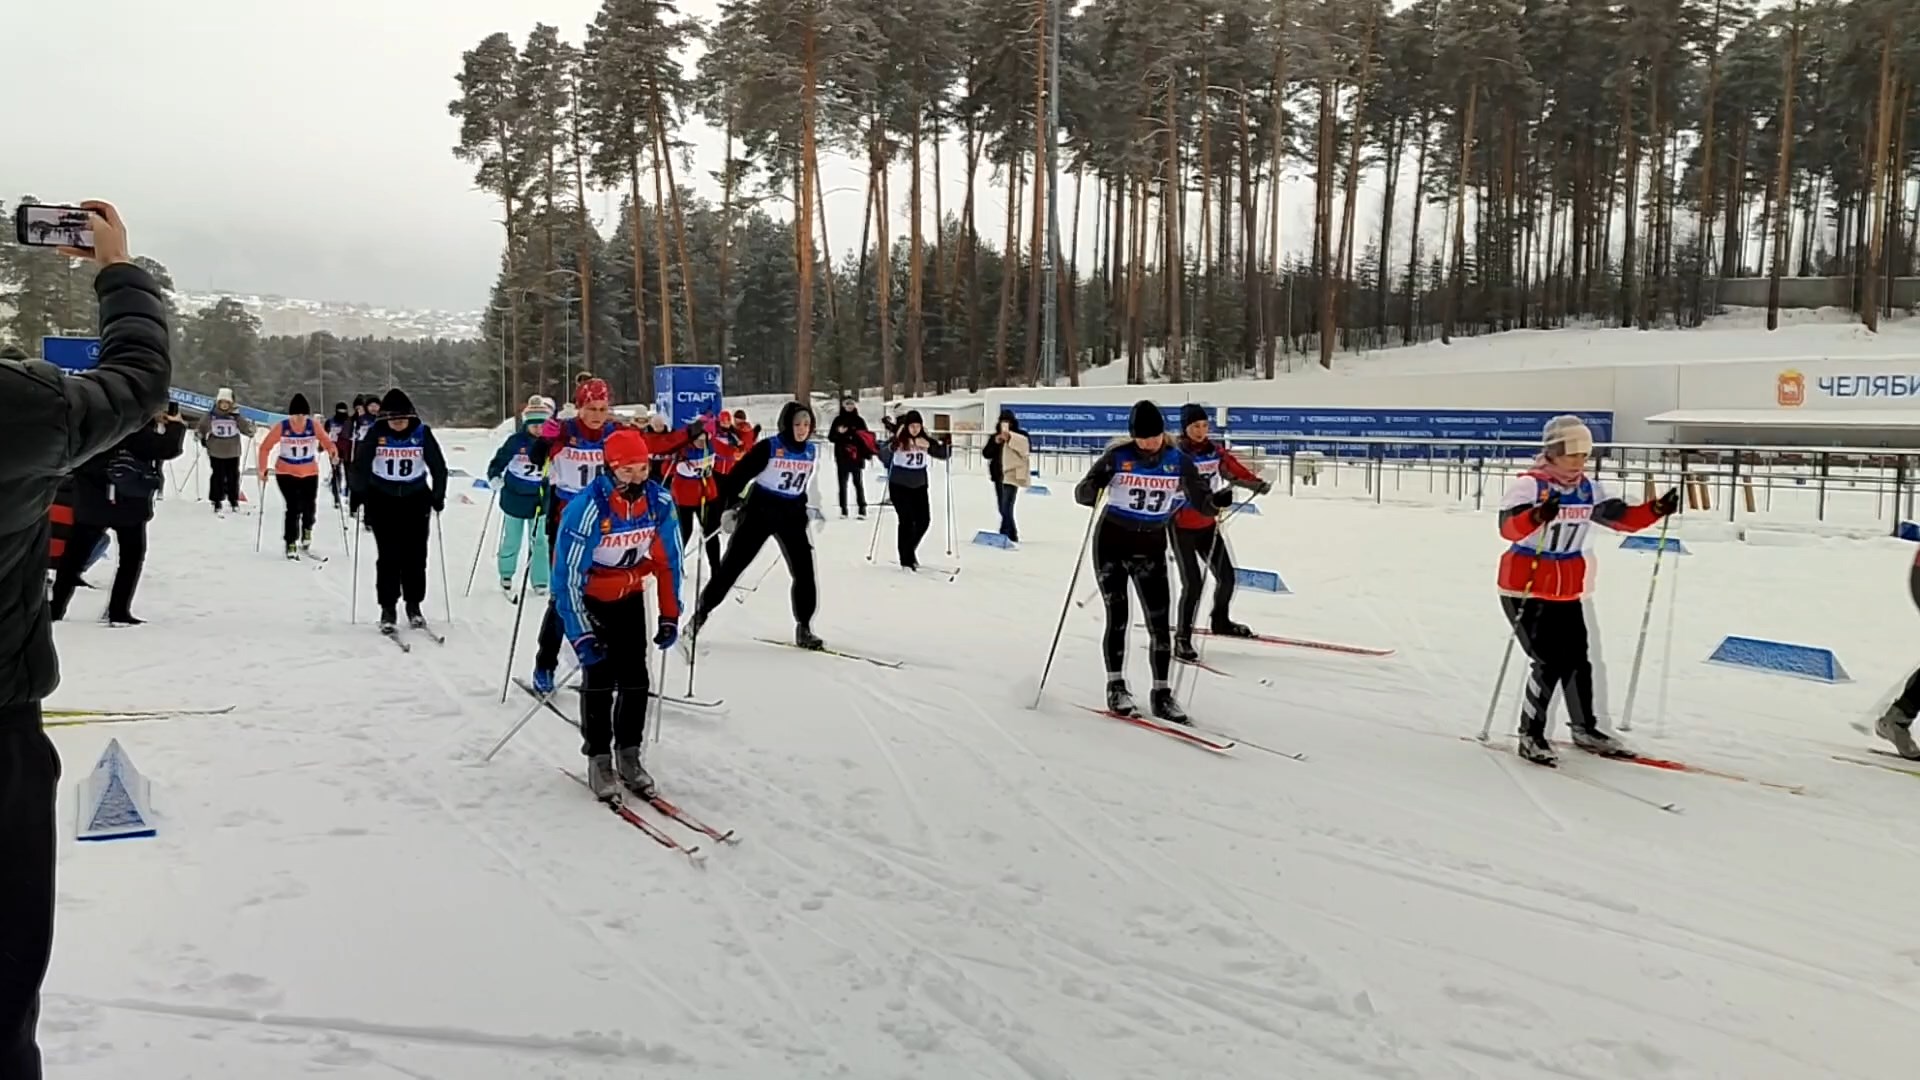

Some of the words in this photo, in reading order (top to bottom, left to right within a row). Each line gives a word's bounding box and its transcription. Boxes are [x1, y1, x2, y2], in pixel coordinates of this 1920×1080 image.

[1818, 375, 1920, 397] ЧЕЛЯБИ
[677, 391, 716, 403] СТАРТ
[216, 425, 233, 436] 31
[290, 446, 309, 457] 11
[905, 452, 924, 465] 29
[385, 458, 414, 477] 18
[777, 471, 807, 492] 34
[1128, 487, 1166, 513] 33
[1549, 522, 1579, 552] 17
